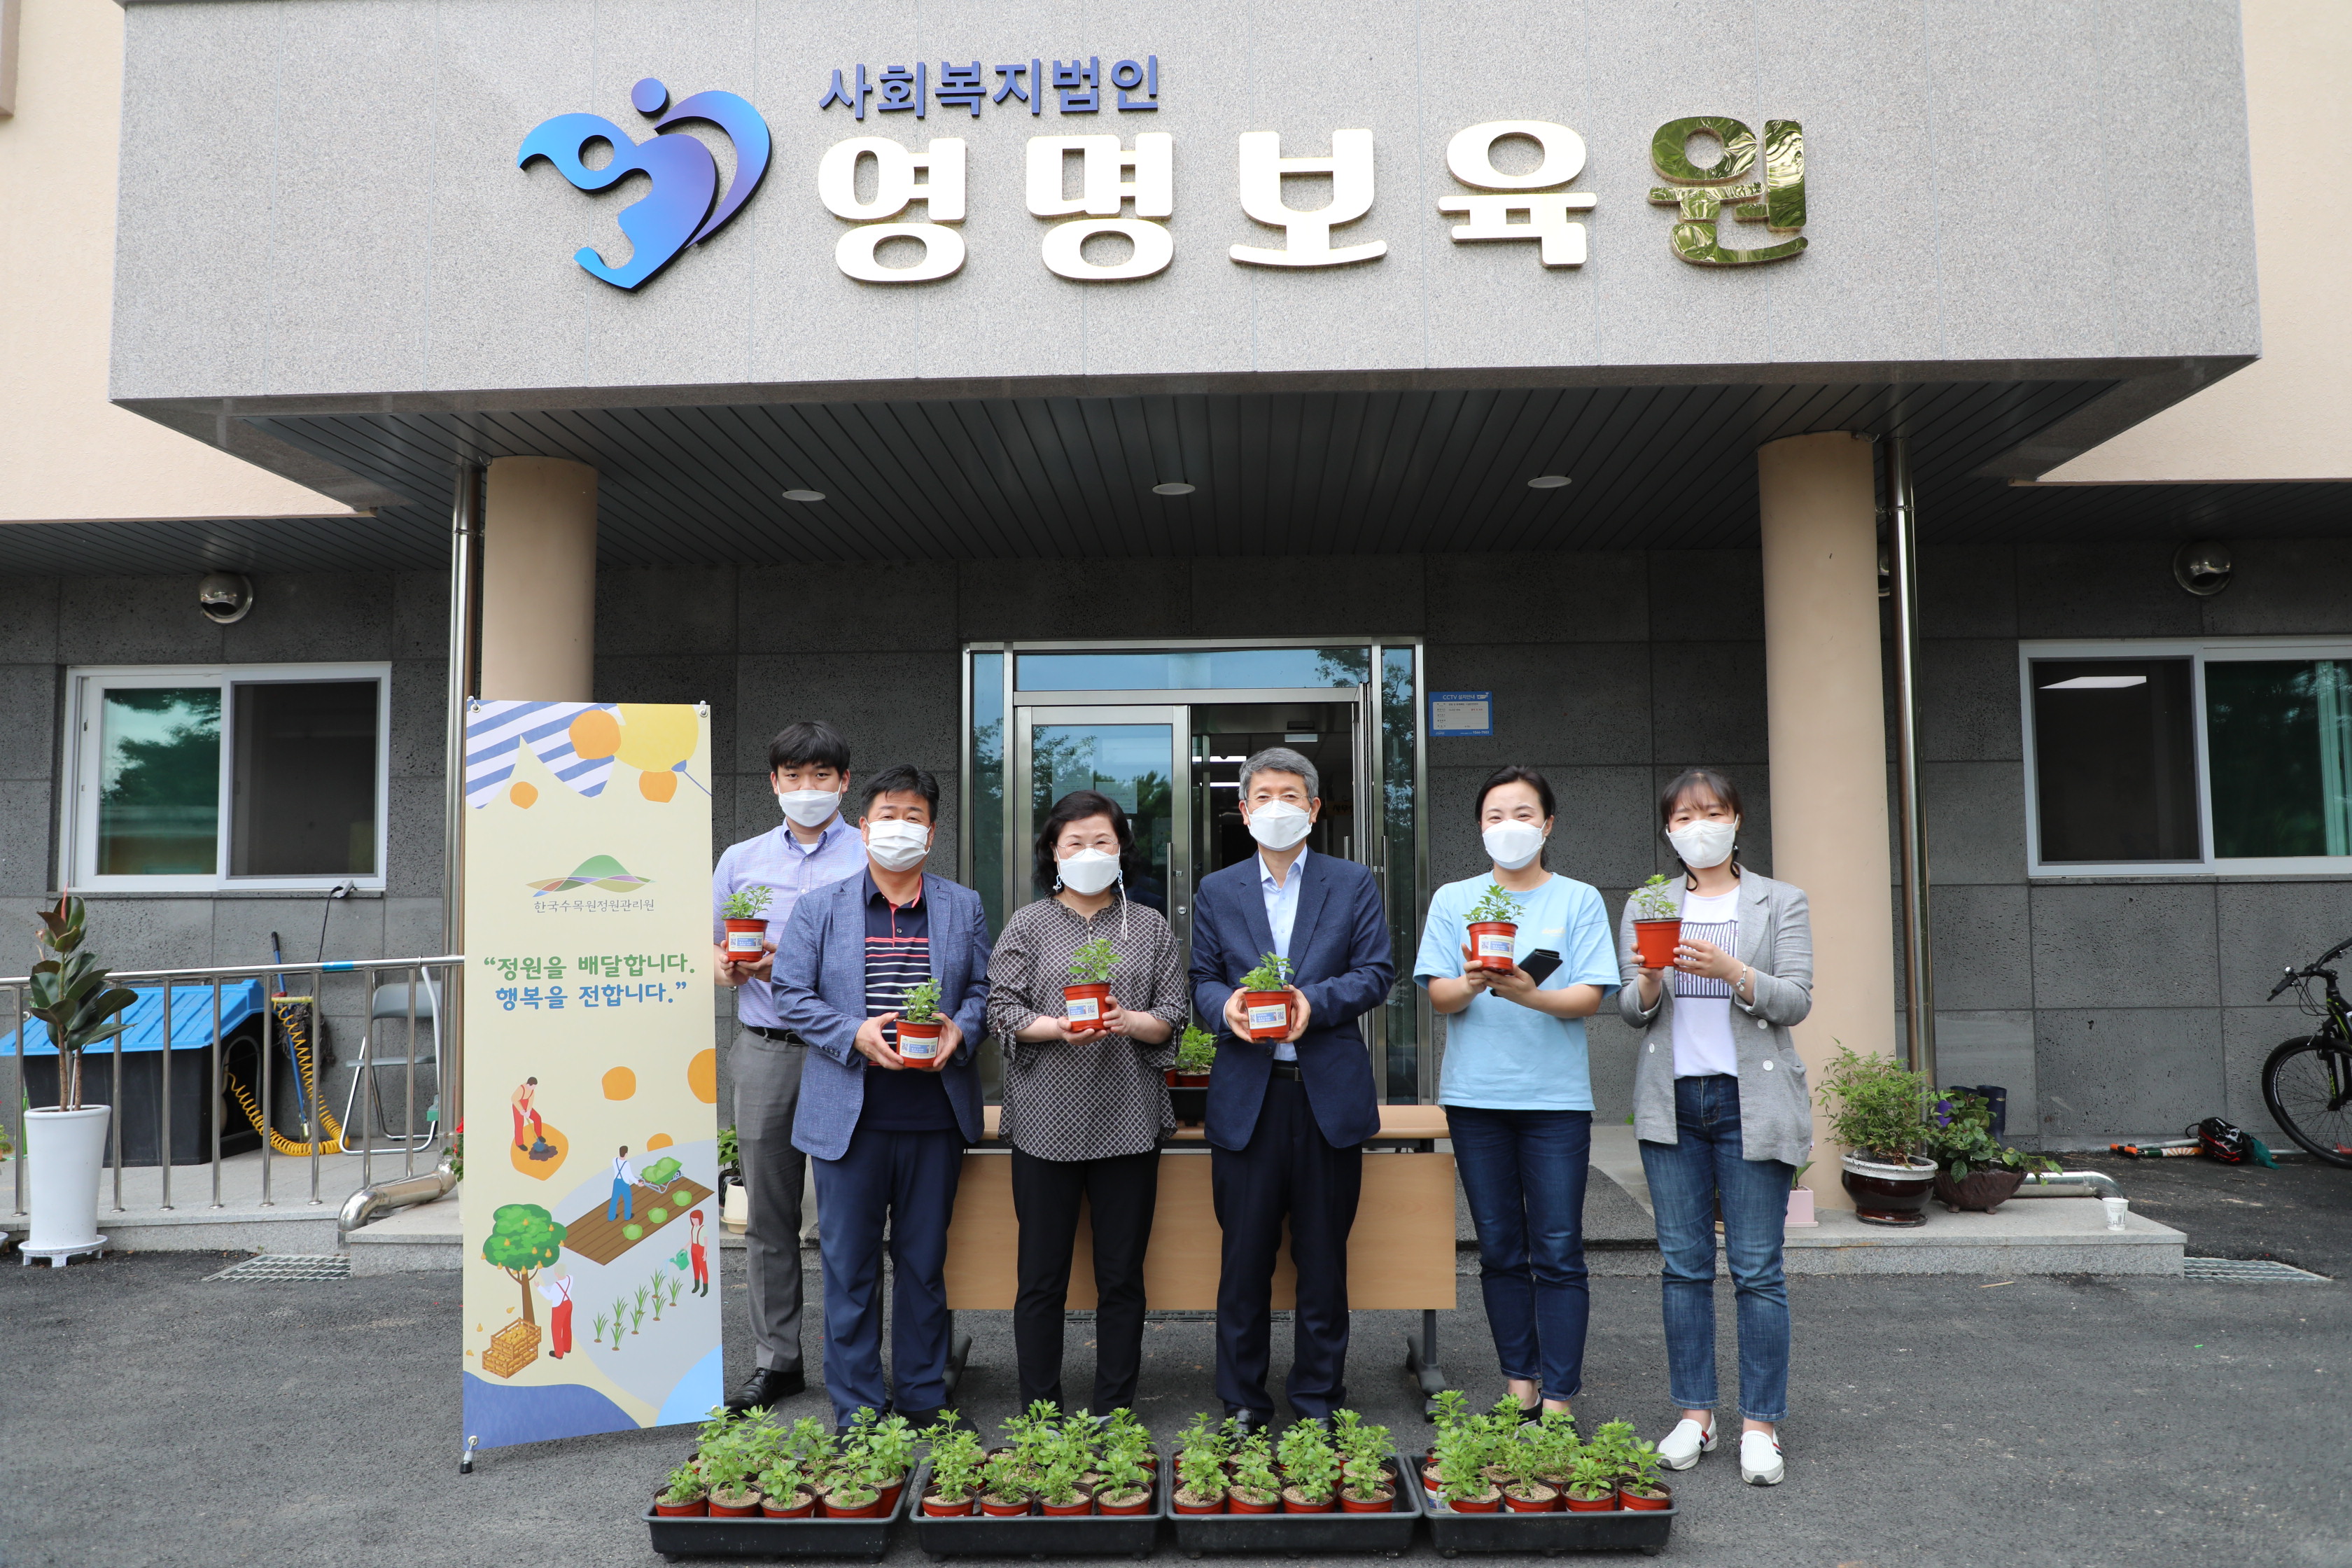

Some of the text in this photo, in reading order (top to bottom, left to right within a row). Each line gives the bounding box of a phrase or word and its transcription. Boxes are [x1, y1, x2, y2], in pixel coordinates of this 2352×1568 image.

[819, 55, 1158, 120] 사회복지법인
[818, 116, 1809, 283] 영명보육원
[534, 899, 654, 913] 한국수목원정원관리원
[484, 953, 696, 981] “정원을 배달합니다.
[496, 981, 687, 1011] 행복을 전합니다.”
